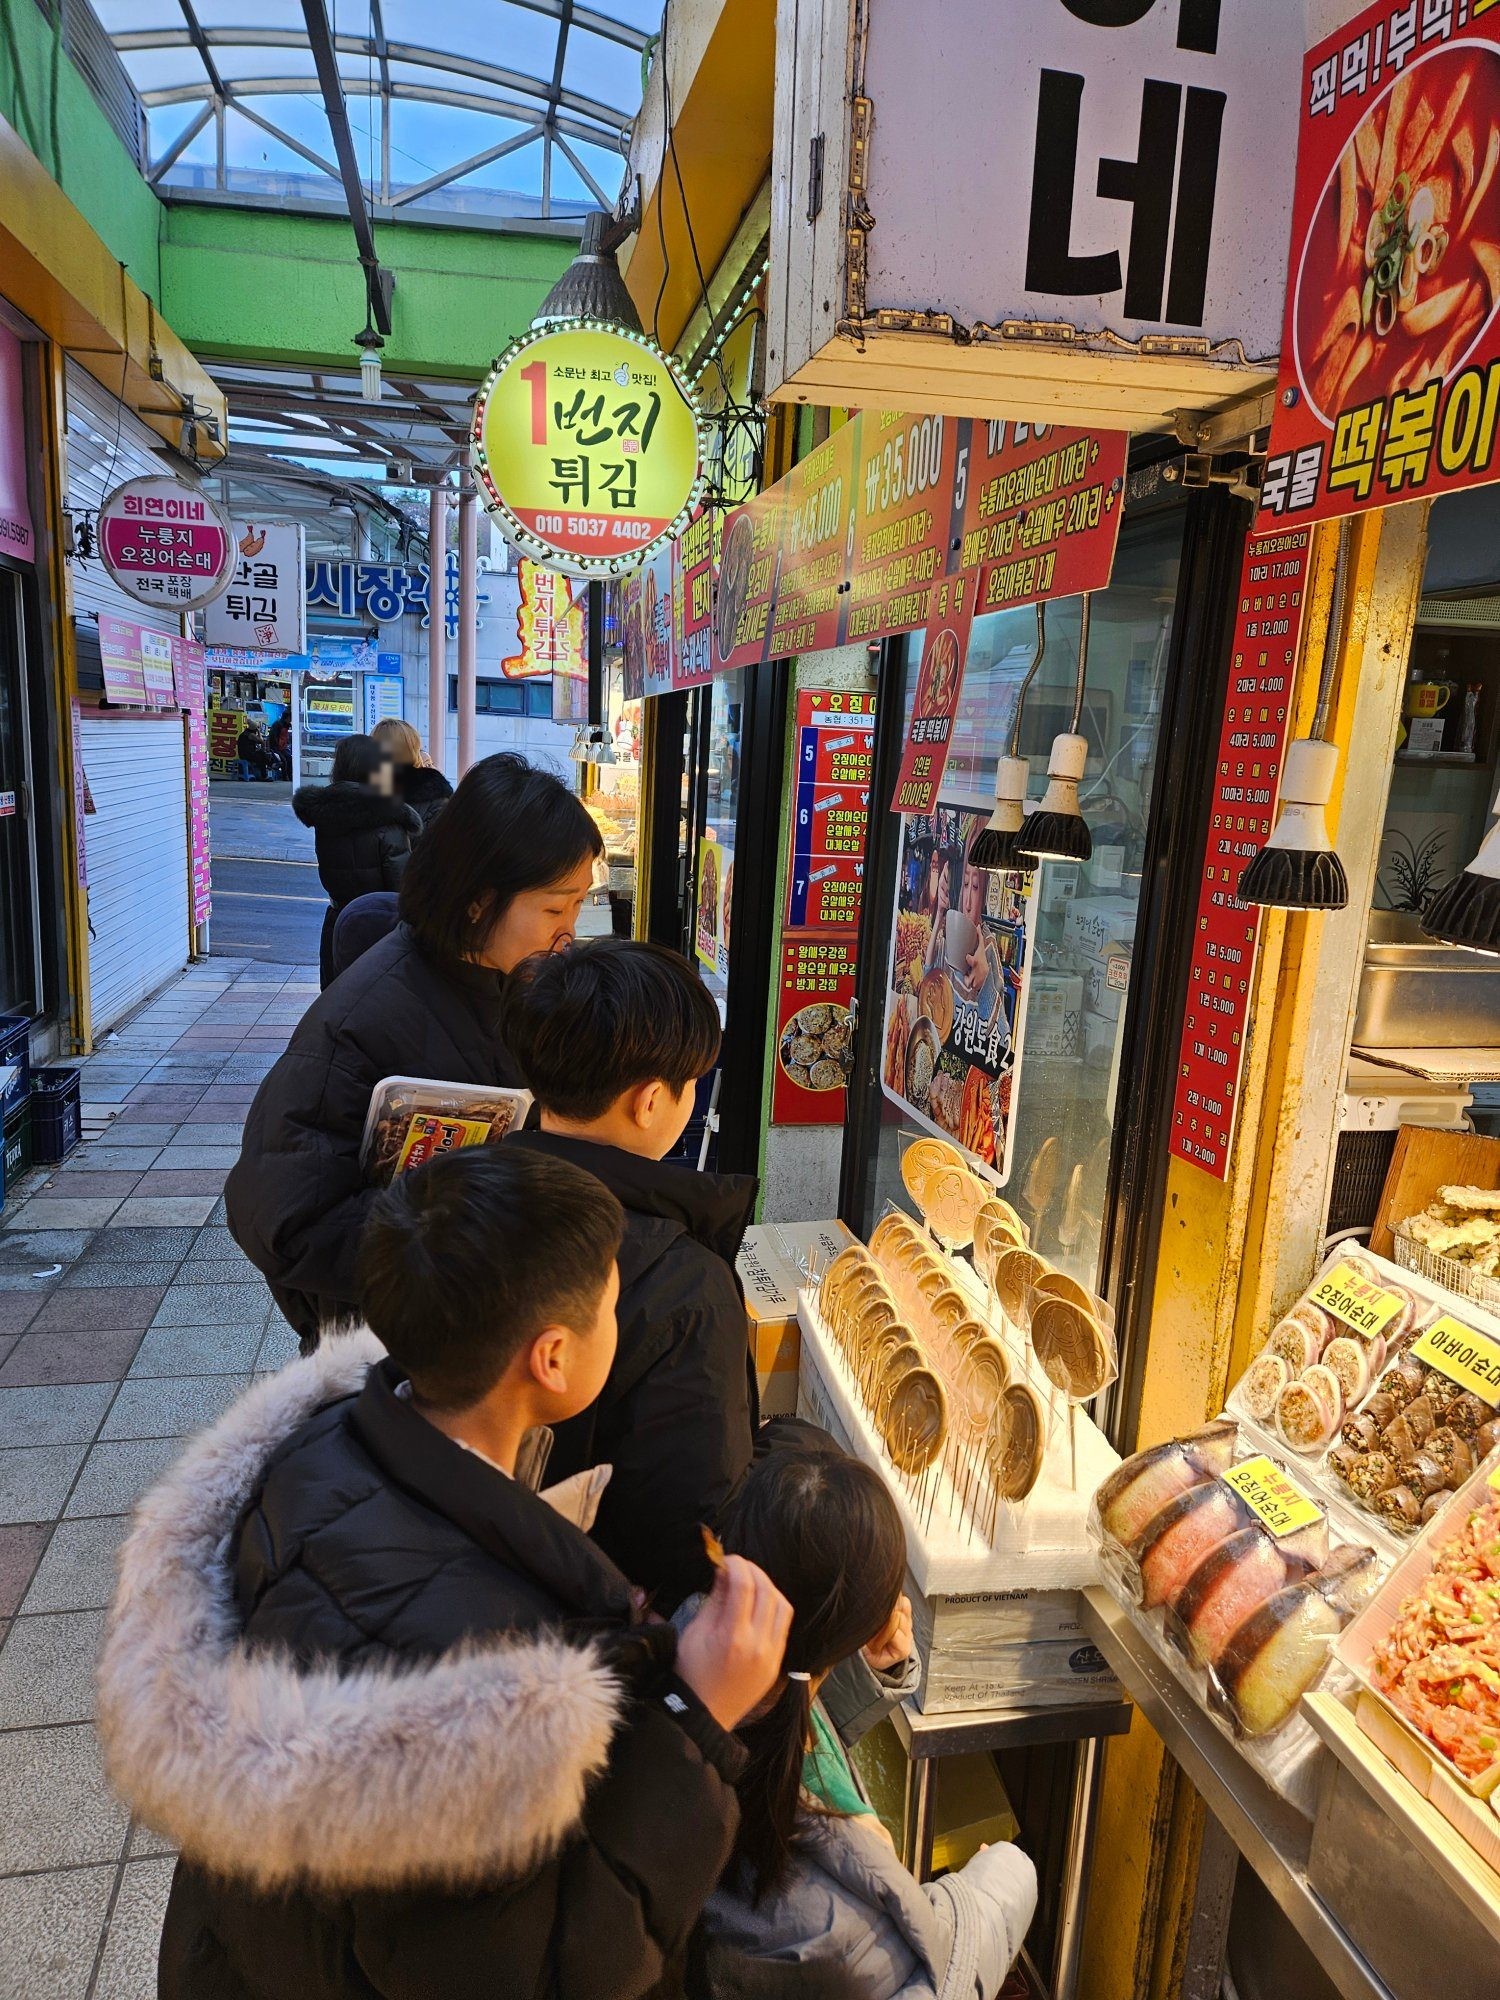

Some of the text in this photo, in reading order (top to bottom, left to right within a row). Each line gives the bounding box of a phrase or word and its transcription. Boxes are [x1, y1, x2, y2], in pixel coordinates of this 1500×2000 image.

[553, 366, 657, 387] 소문난 최고 맛집!
[521, 360, 661, 454] 1번지
[1261, 360, 1500, 514] 국물 떡볶이
[549, 454, 638, 509] 튀김
[955, 448, 968, 510] 5
[979, 452, 1059, 520] 누룽지오징어순대
[1058, 438, 1089, 489] 1마리
[123, 494, 205, 521] 희연이네
[1067, 485, 1103, 534] 2마리
[138, 525, 194, 548] 누룽지
[535, 514, 651, 540] 010 5037 4402
[846, 507, 856, 557] 6
[1249, 532, 1307, 557] 누룽지오징어순대
[120, 548, 212, 570] 오징어순대
[986, 551, 1057, 605] 오징어튀김 1개
[1250, 560, 1300, 582] 1마리 17,000
[136, 574, 192, 592] 전국 포장
[167, 586, 192, 600] 택배
[306, 560, 411, 622] 시장
[225, 595, 278, 622] 튀김
[1246, 619, 1289, 637] 1줄 12,000
[1236, 677, 1284, 693] 2마리 4,000
[211, 713, 239, 758] 포장
[1229, 733, 1276, 748] 4마리 5,000
[805, 745, 814, 762] 5
[914, 755, 933, 777] 2인분
[898, 780, 933, 810] 8000원
[1221, 786, 1270, 804] 10마리 5,000
[800, 808, 809, 825] 6
[825, 839, 860, 852] 대게순살
[1218, 840, 1257, 858] 2개 4,000
[796, 880, 805, 896] 7
[1211, 891, 1225, 906] 4개
[819, 909, 855, 922] 대게순살
[798, 945, 848, 960] 왕새우강정
[1206, 942, 1242, 964] 1컵 5,000
[797, 961, 827, 976] 왕순살
[796, 978, 838, 992] 방게 강정
[1200, 992, 1235, 1015] 1컵 5,000
[1194, 1041, 1228, 1066] 1개 1,000
[1187, 1090, 1222, 1116] 2장 1,000
[1182, 1137, 1216, 1166] 1개 2,000
[1344, 1276, 1386, 1307] 누룽지
[1316, 1284, 1380, 1331] 오징어순대
[1231, 1472, 1292, 1528] 오징어순대
[1263, 1472, 1304, 1507] 누룽지
[945, 1592, 1029, 1604] PRODUCT OF VIETNAM
[944, 1685, 966, 1694] Keep
